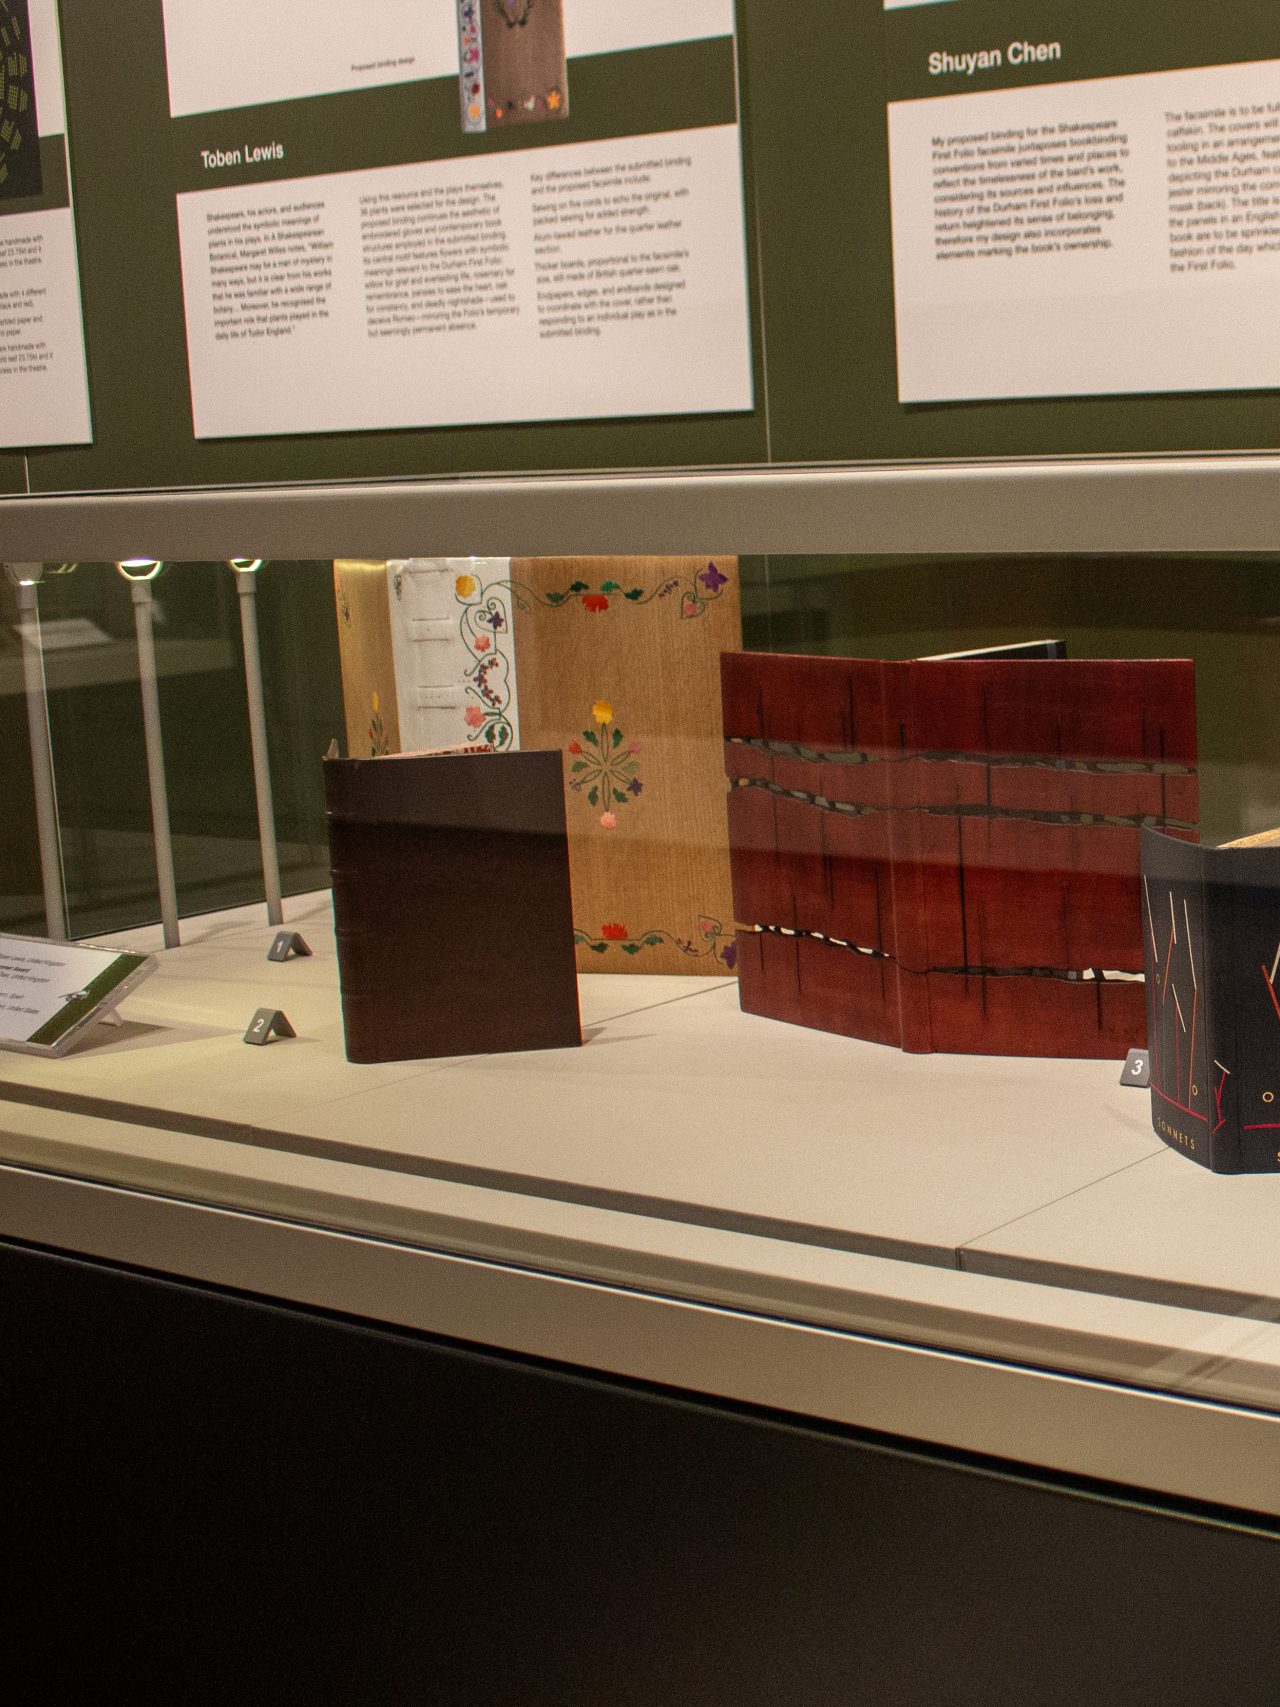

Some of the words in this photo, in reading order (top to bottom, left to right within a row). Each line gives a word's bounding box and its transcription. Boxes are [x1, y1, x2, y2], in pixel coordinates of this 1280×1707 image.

[929, 49, 1001, 76] Shuyan
[1008, 41, 1061, 65] Chen
[201, 150, 241, 169] Toben
[245, 141, 284, 164] Lewis
[276, 941, 284, 952] 1
[252, 1019, 264, 1033] 2
[1131, 1060, 1143, 1075] 3
[1158, 1117, 1195, 1150] SONNETS
